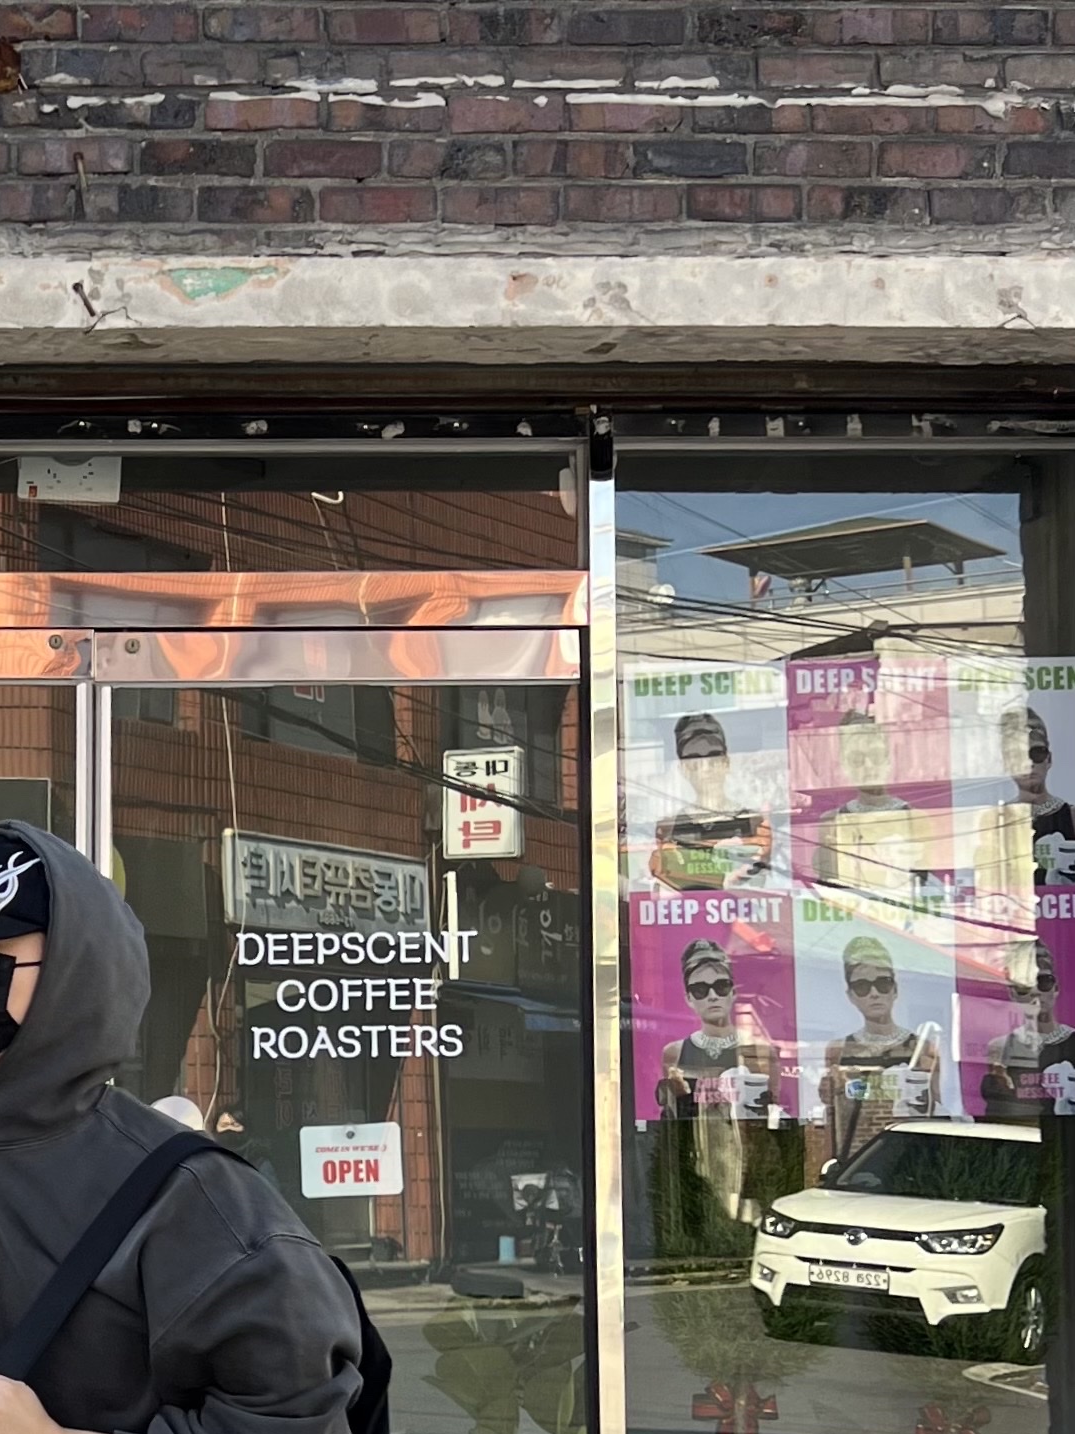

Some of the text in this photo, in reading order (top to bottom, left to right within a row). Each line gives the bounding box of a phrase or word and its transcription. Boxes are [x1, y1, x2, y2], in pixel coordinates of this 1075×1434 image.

[634, 670, 775, 697] DEEP SCENT
[796, 666, 937, 694] DEEP SCENT
[1024, 665, 1075, 691] SCEN
[639, 898, 783, 925] DEEP SCENT
[802, 899, 856, 922] DEEP
[236, 930, 478, 966] DEEPSCENT
[276, 978, 438, 1012] COFFEE
[251, 1024, 464, 1059] ROASTERS
[322, 1159, 380, 1184] OPEN
